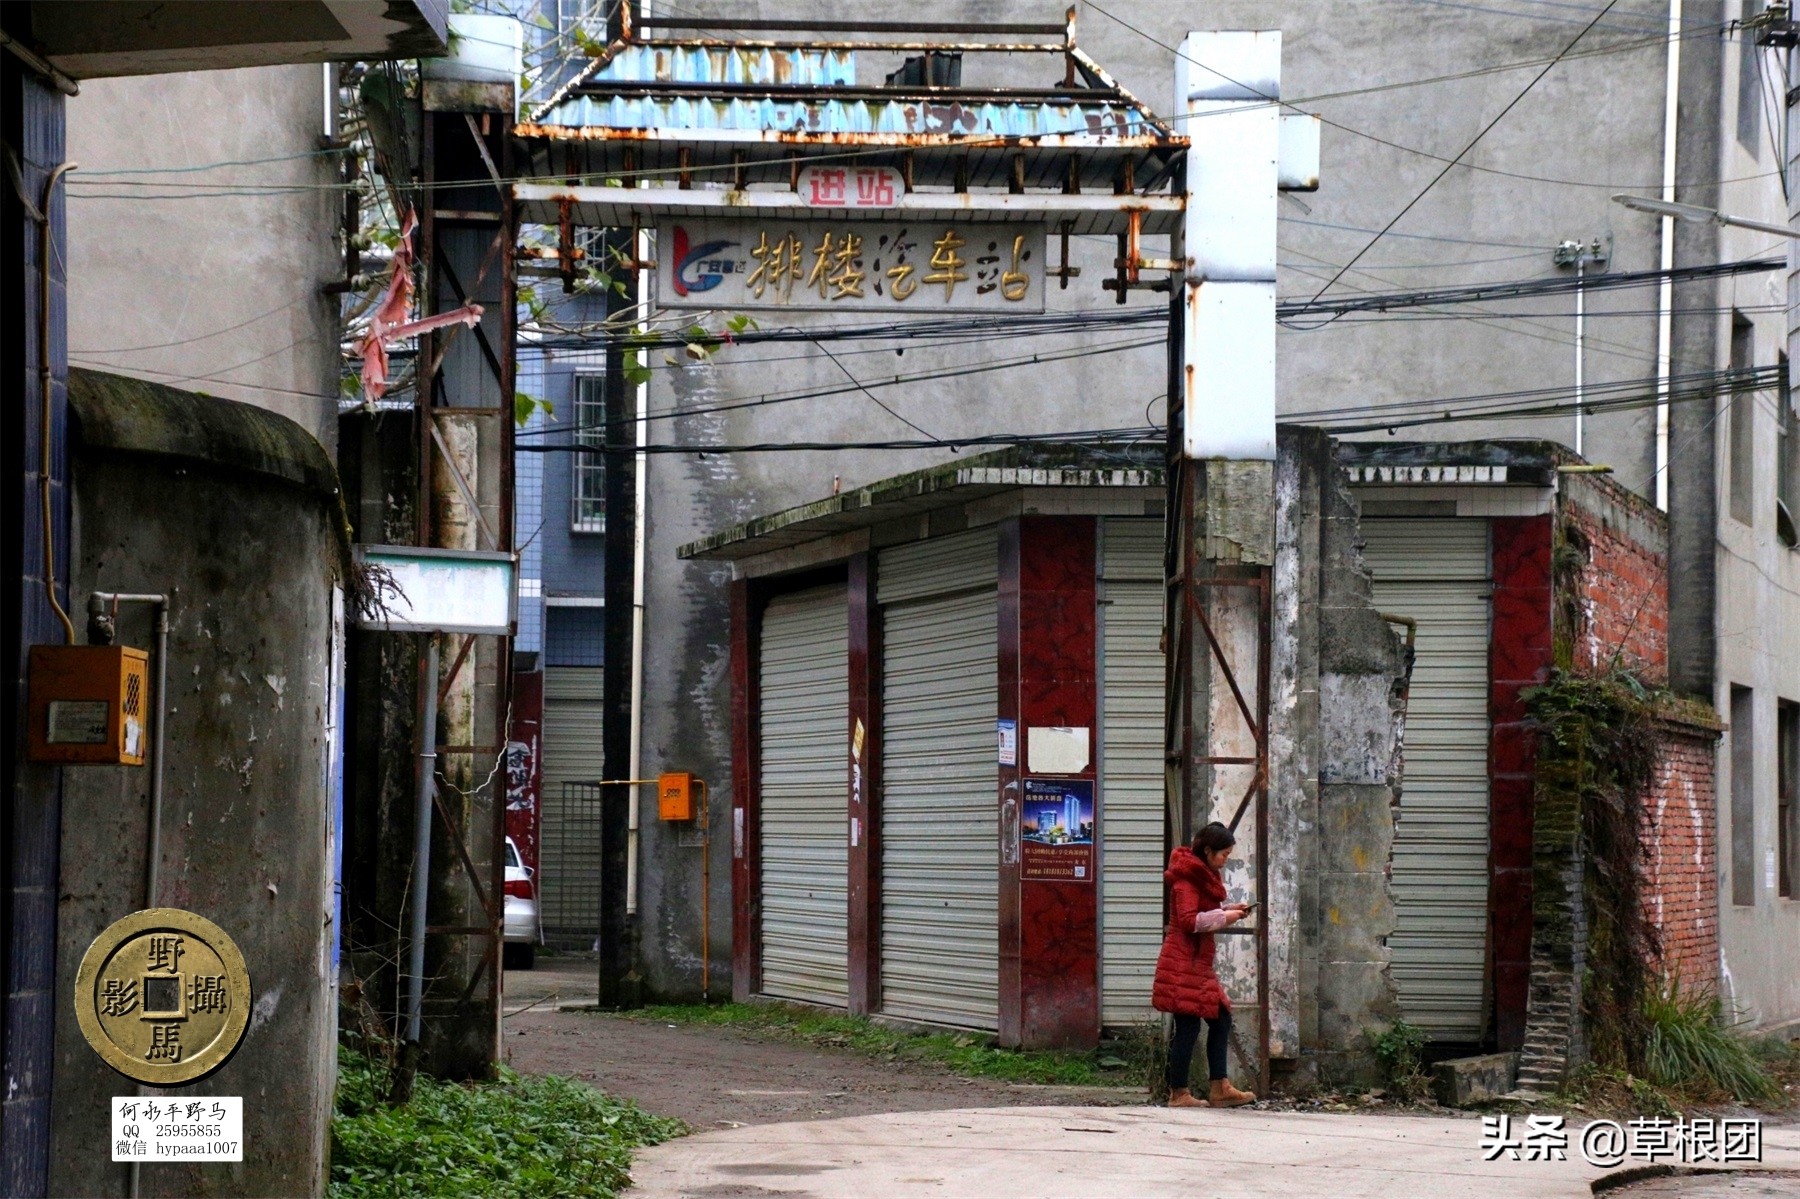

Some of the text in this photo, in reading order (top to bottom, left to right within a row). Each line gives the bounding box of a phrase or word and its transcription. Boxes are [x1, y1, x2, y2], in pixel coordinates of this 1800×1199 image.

[809, 168, 894, 206] 进站
[746, 229, 1031, 303] 排楼汽车站
